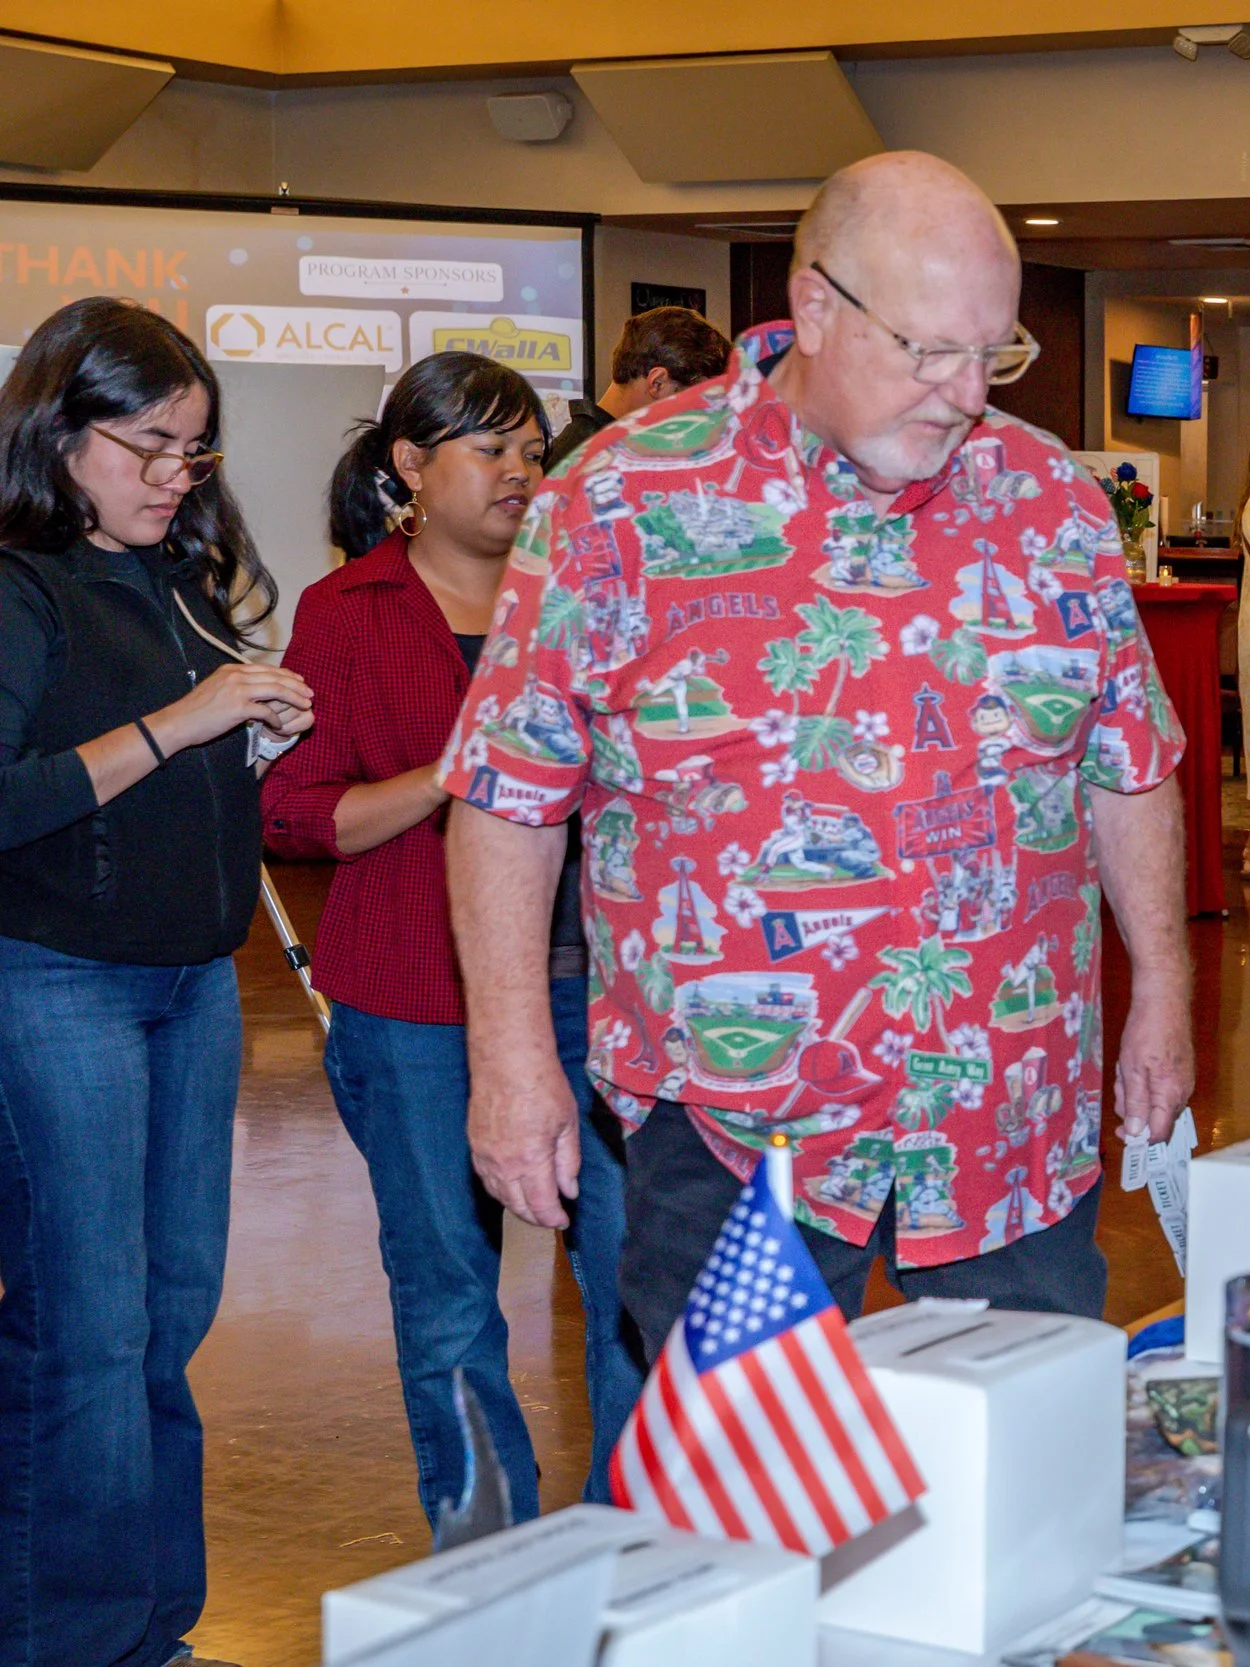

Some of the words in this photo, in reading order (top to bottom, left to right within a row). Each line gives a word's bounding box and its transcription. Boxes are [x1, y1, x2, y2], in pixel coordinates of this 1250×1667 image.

[308, 262, 397, 279] PROGRAM
[403, 266, 497, 283] SPONSORS
[276, 321, 393, 352] ALCAL
[664, 591, 781, 643] ANGELS
[926, 828, 961, 843] WIN
[1155, 1180, 1173, 1209] TICKET
